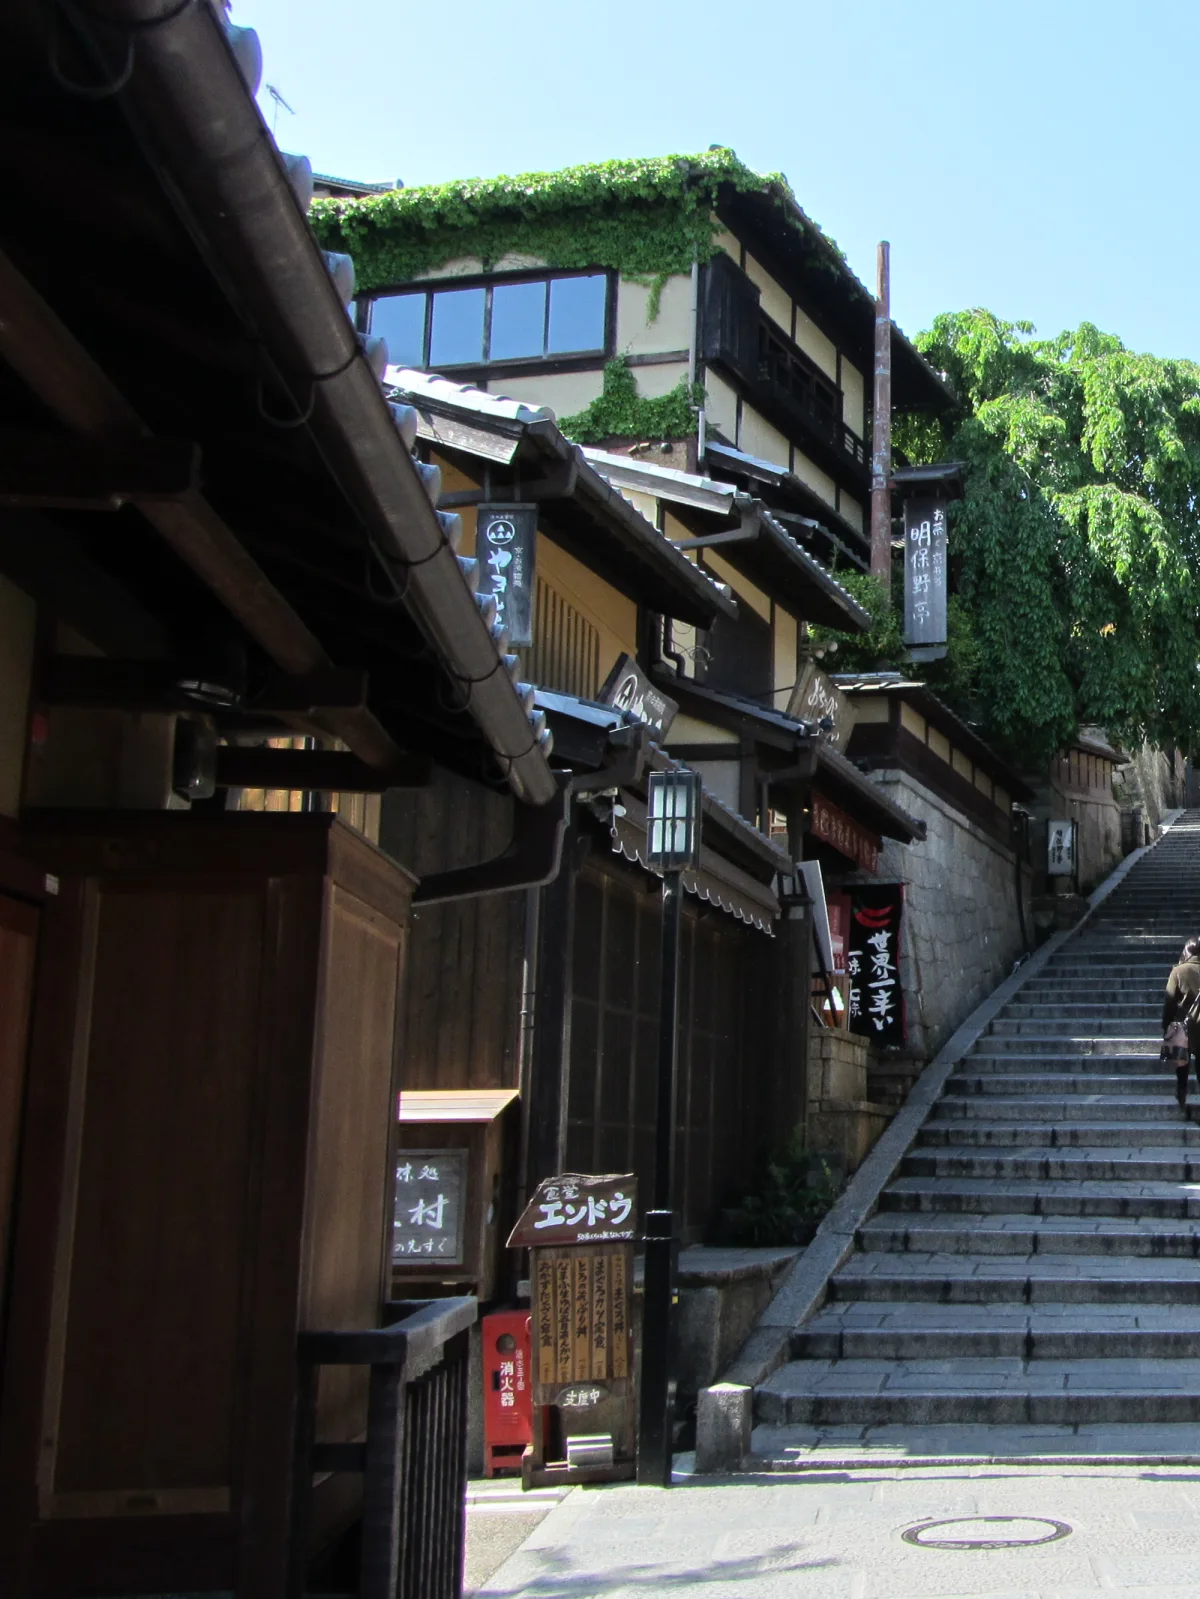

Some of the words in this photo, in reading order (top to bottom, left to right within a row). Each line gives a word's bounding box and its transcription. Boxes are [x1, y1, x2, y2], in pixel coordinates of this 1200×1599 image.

[910, 520, 930, 625] 明保野亭
[867, 929, 898, 1032] 世界一辛い
[394, 1193, 450, 1229] 村
[533, 1192, 632, 1229] エンドウ
[543, 1185, 580, 1201] 食堂
[500, 1361, 515, 1407] 消火器
[562, 1388, 600, 1407] 支度中
